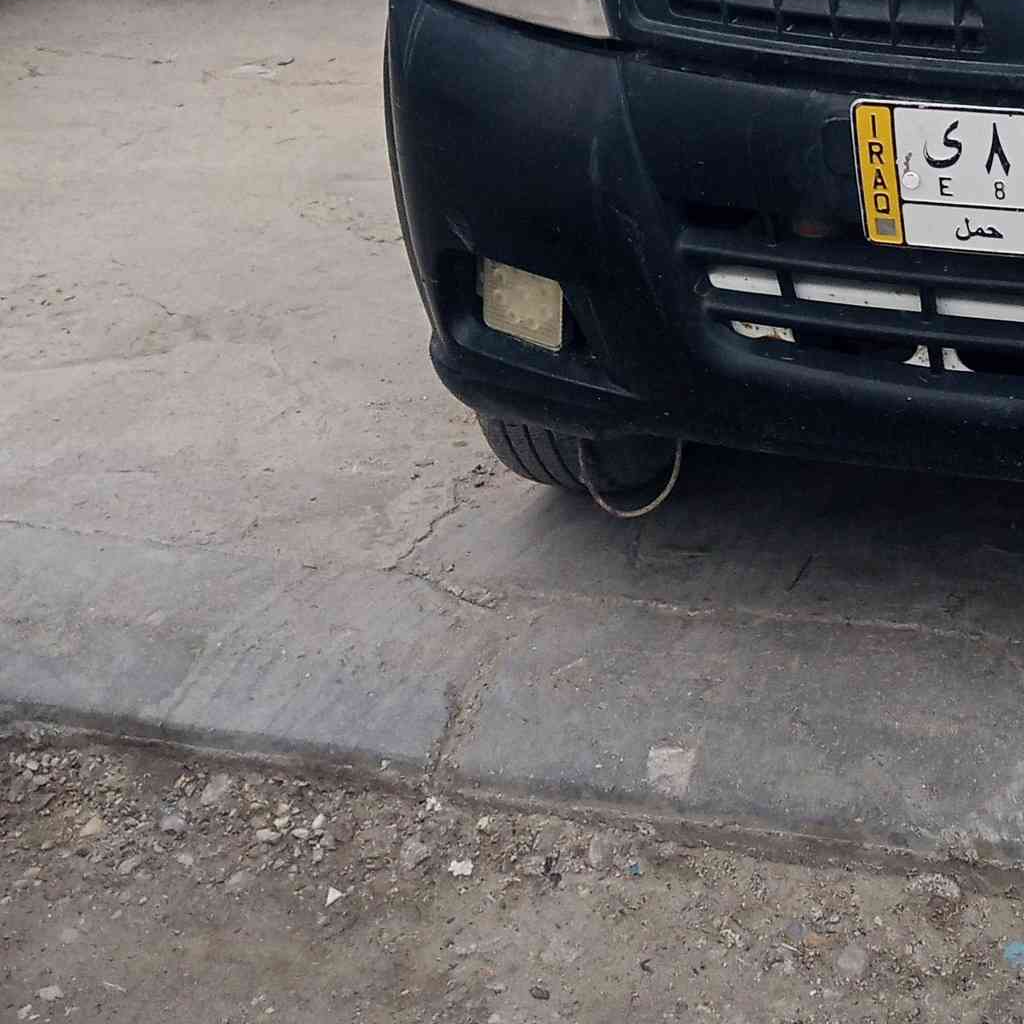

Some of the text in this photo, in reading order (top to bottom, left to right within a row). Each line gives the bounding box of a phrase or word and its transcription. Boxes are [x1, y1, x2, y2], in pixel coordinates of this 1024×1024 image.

[868, 114, 891, 215] IRAQ
[938, 177, 953, 197] E
[955, 217, 1004, 241] حمل
